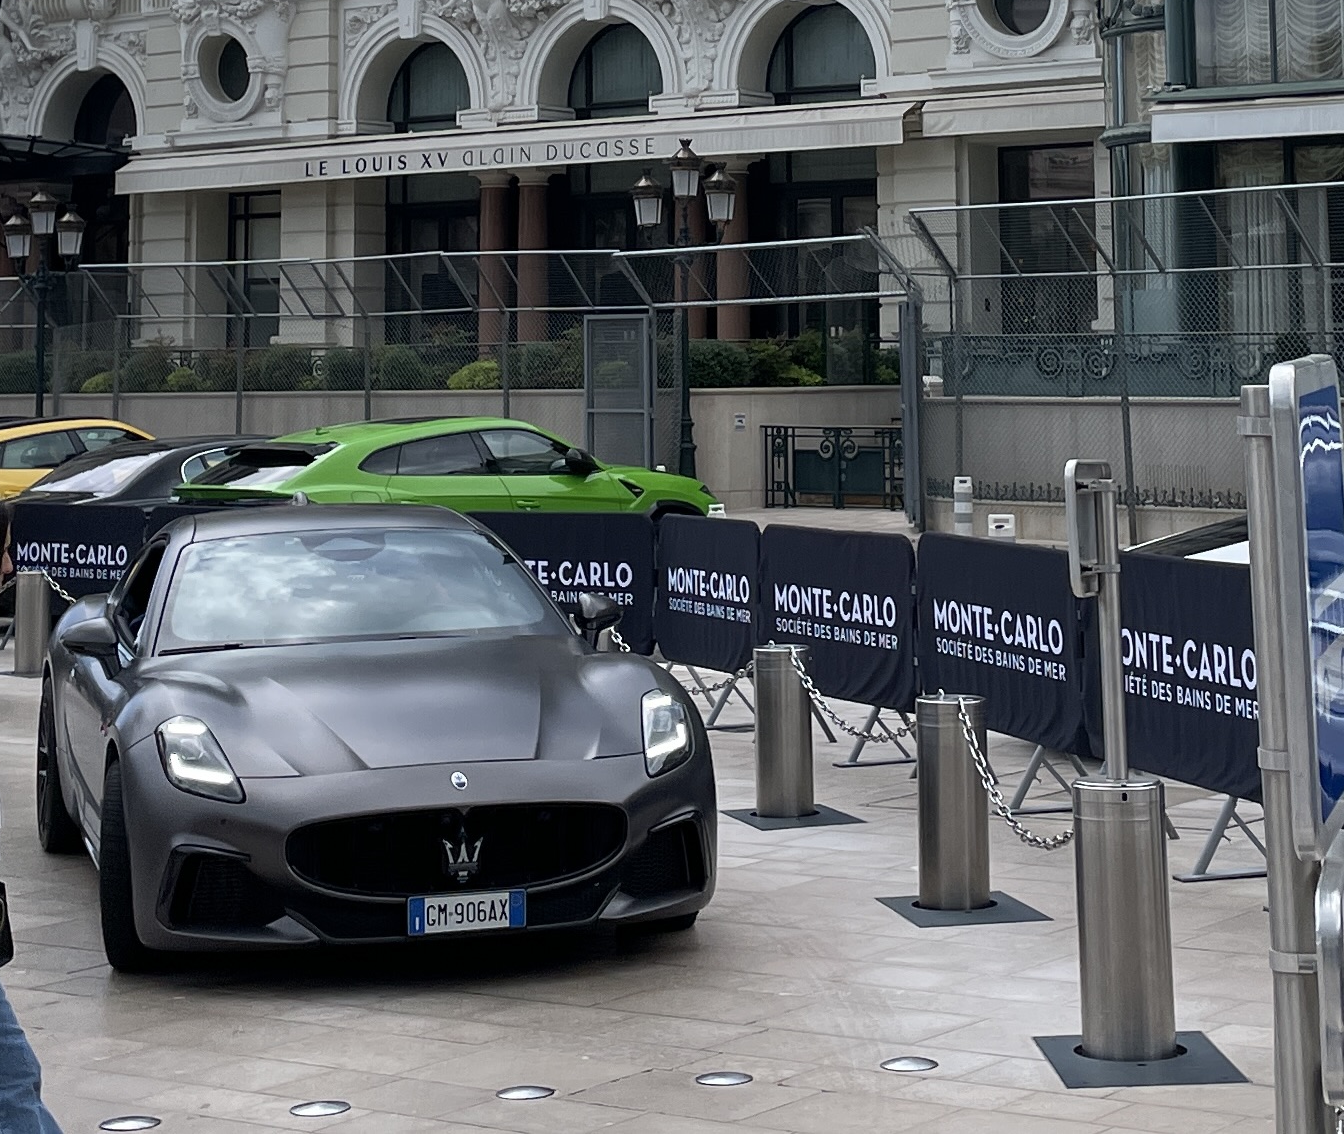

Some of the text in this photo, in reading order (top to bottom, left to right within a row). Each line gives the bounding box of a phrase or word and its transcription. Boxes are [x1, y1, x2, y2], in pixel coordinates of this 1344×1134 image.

[305, 161, 328, 177] LE
[342, 155, 407, 175] LOUIS
[421, 152, 448, 169] XV
[51, 566, 68, 578] DES
[69, 568, 95, 580] BAINS
[96, 569, 108, 580] DE
[668, 596, 752, 624] SOCIÉTÉ DES BAINS DE MER
[775, 616, 898, 651] SOCIÉTÉ DES BAINS DE MER
[936, 636, 1067, 682] SOCIÉTÉ DES BAINS DE MER
[1124, 670, 1148, 697] IÉTÉ
[1151, 679, 1173, 702] DES
[1176, 684, 1212, 712] BAINS
[1215, 693, 1232, 716] DE
